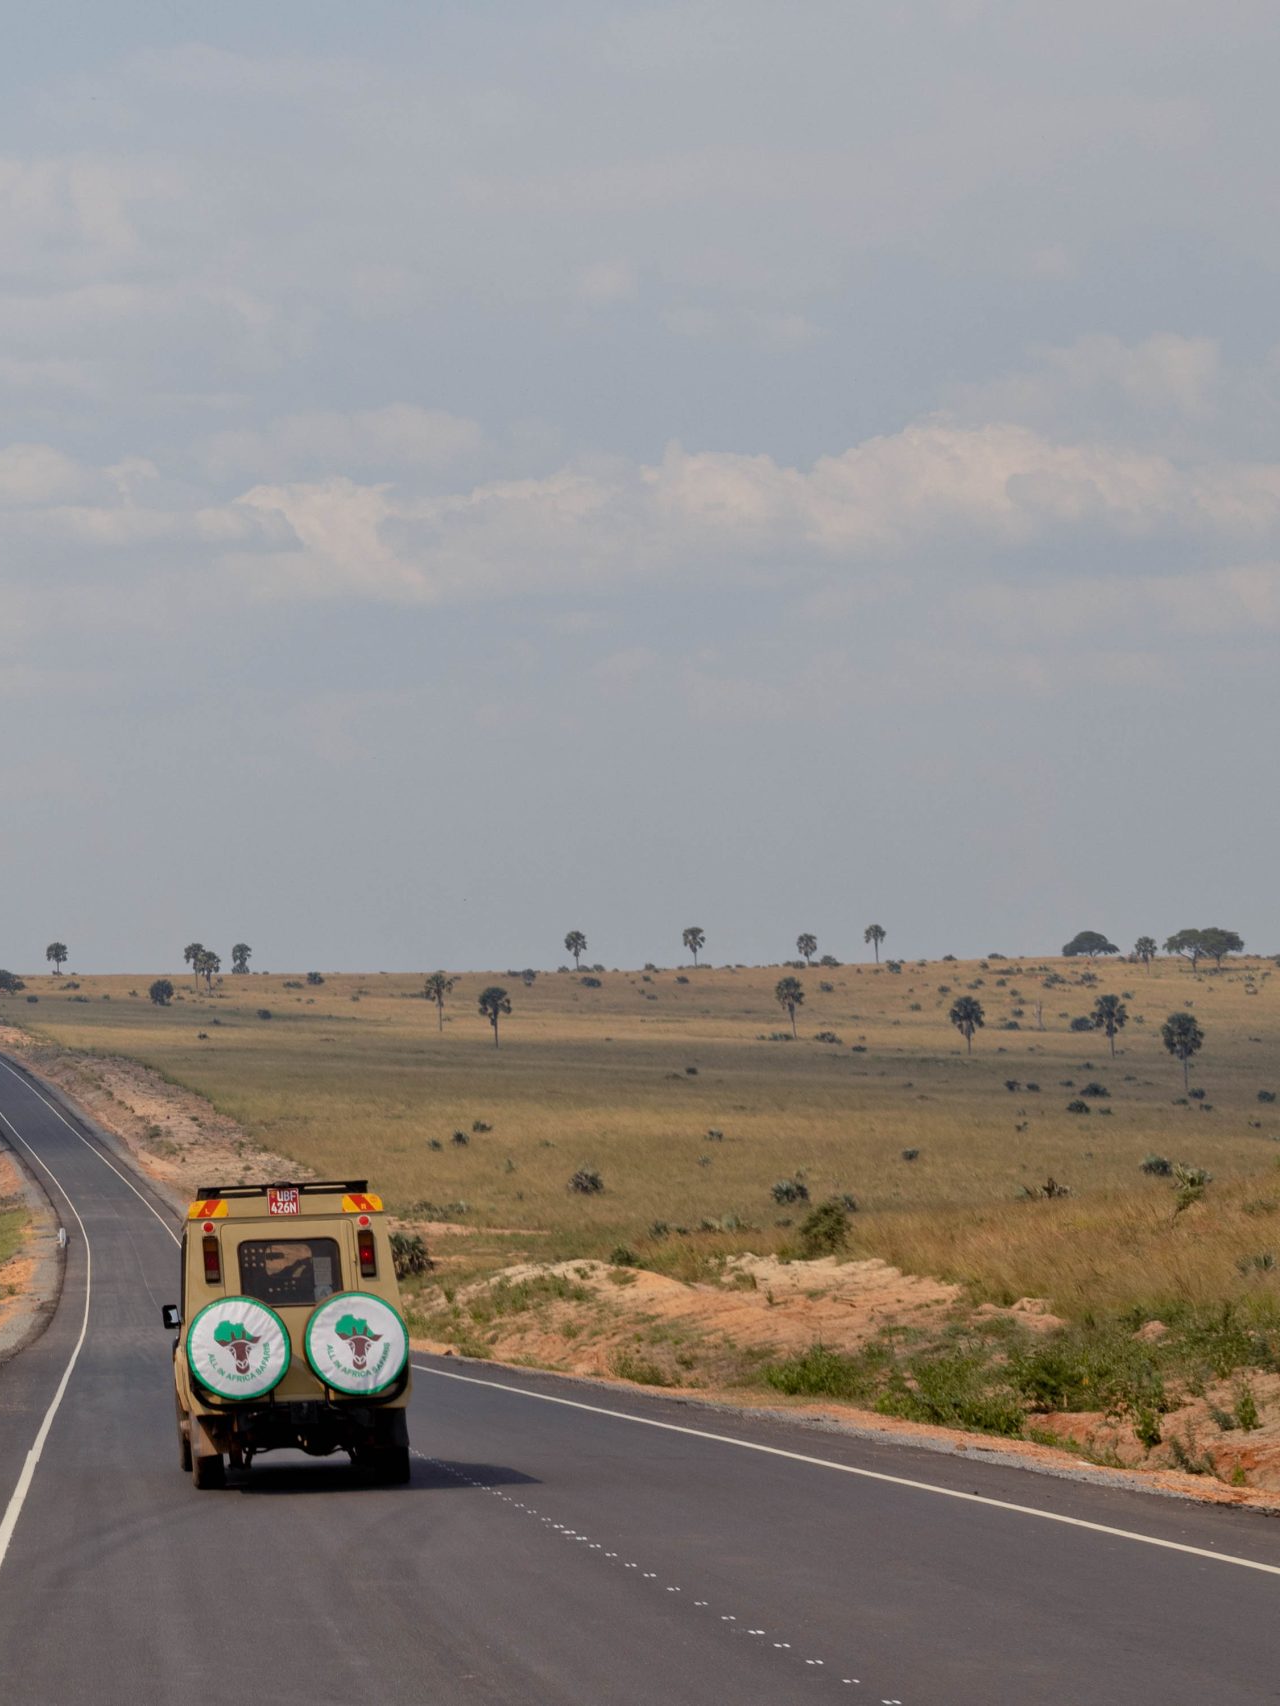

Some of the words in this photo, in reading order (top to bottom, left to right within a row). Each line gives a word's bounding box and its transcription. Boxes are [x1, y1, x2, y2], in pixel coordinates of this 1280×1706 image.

[271, 1202, 297, 1214] 426N
[208, 1353, 218, 1369] ALL
[217, 1368, 226, 1377] IN
[226, 1372, 256, 1383] AFRICA
[255, 1342, 271, 1376] SAFARIS
[326, 1344, 335, 1361] ALL
[333, 1360, 342, 1370] IN
[341, 1367, 372, 1378] AFRICA
[372, 1342, 391, 1374] SAFARIS
